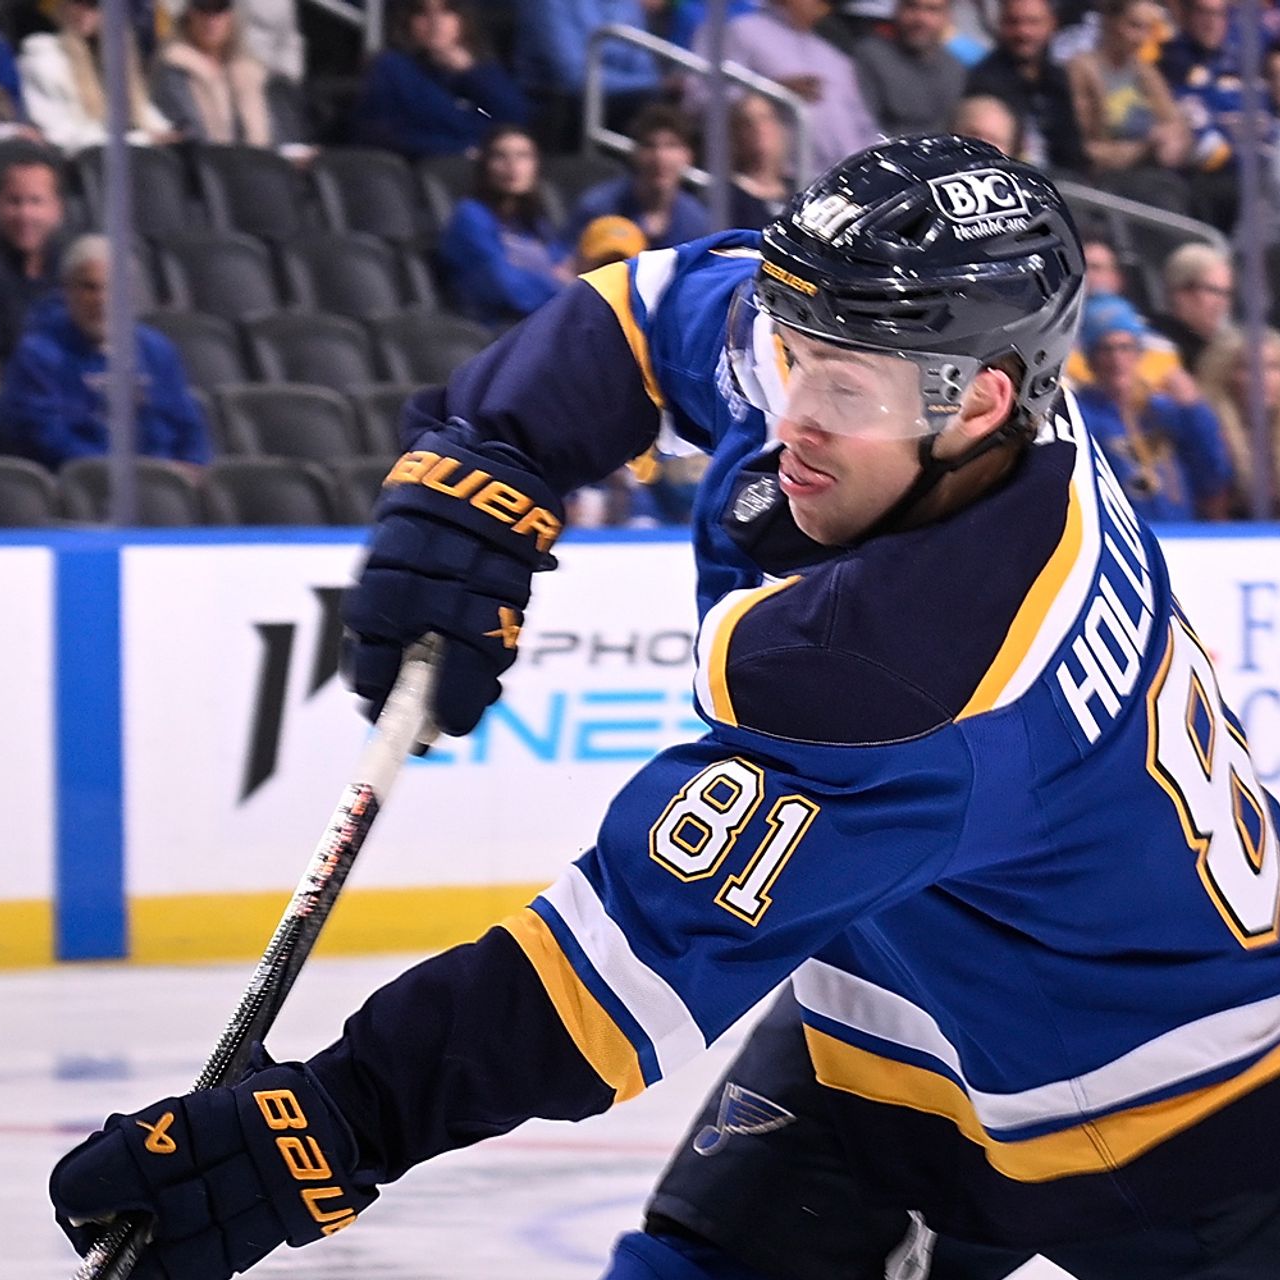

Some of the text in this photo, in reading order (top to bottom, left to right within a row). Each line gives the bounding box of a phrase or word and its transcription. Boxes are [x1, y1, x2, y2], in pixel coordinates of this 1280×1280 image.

[940, 174, 1017, 216] BJC
[381, 450, 562, 553] AUER
[648, 755, 821, 928] 81
